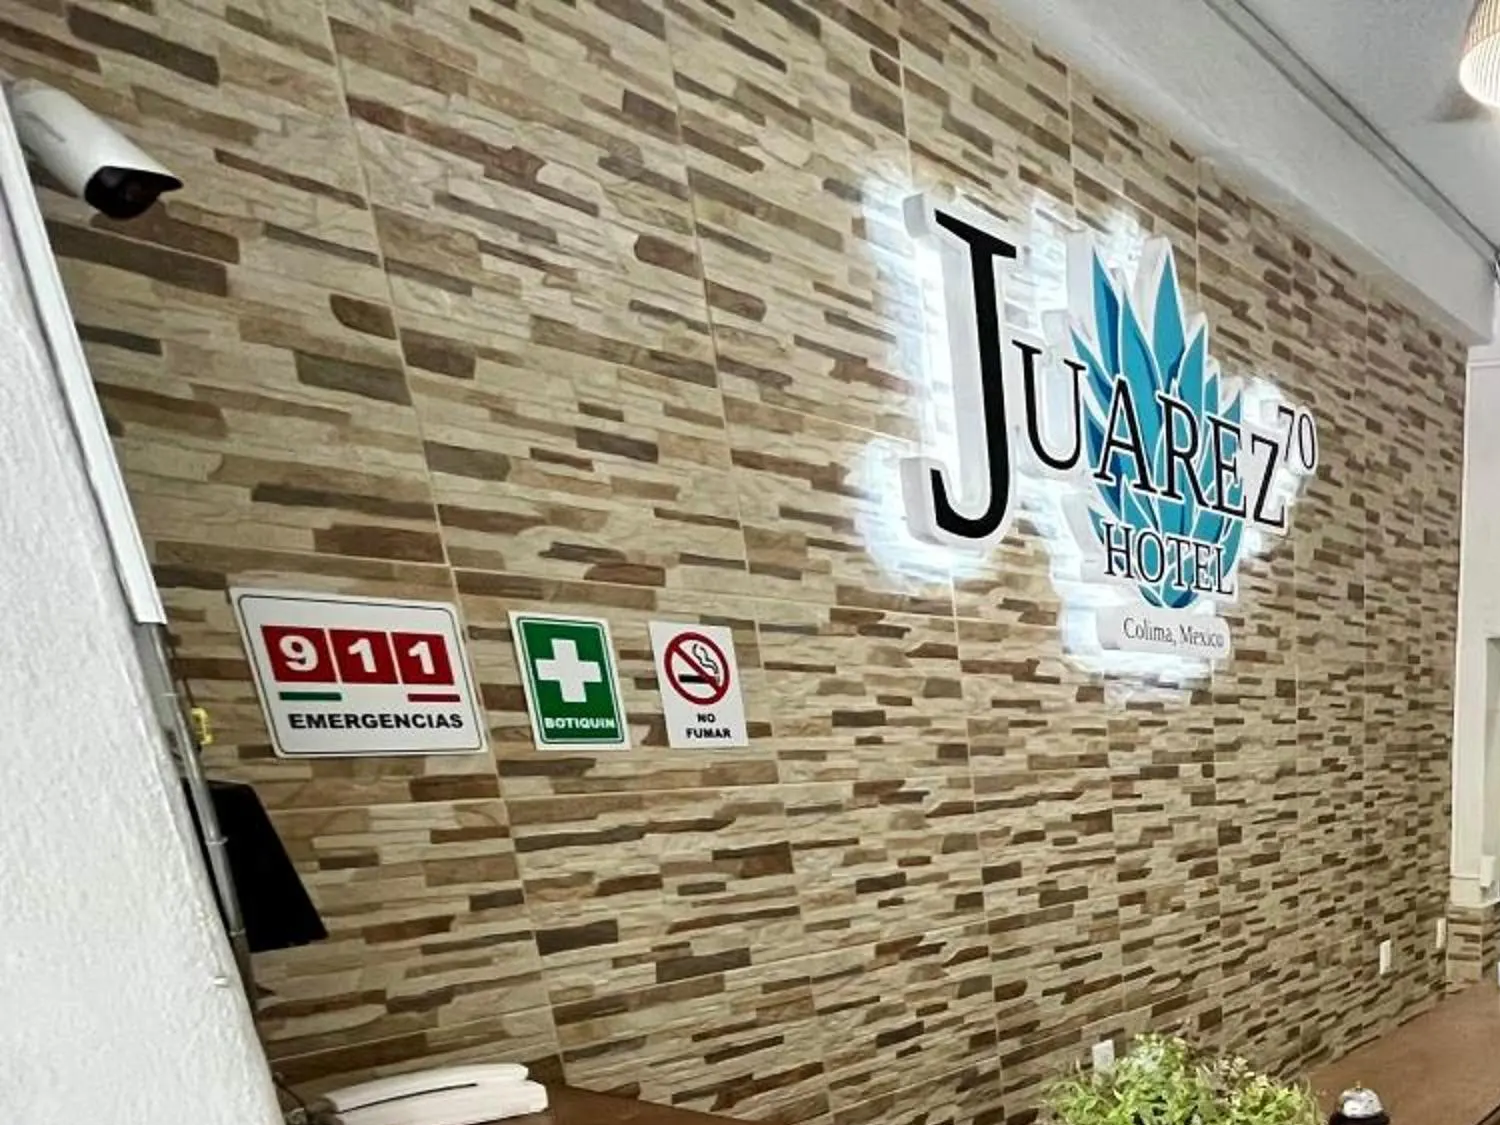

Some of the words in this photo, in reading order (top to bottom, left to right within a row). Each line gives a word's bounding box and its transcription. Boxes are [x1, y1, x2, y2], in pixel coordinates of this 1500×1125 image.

[1279, 405, 1316, 470] 70
[1102, 522, 1234, 595] HOTEL
[1123, 617, 1177, 646] Colima,
[278, 634, 436, 676] 911
[288, 712, 464, 731] EMERGENCIAS
[545, 716, 616, 729] BOTIQUIN
[697, 713, 716, 723] NO
[685, 728, 732, 739] FUMAR
